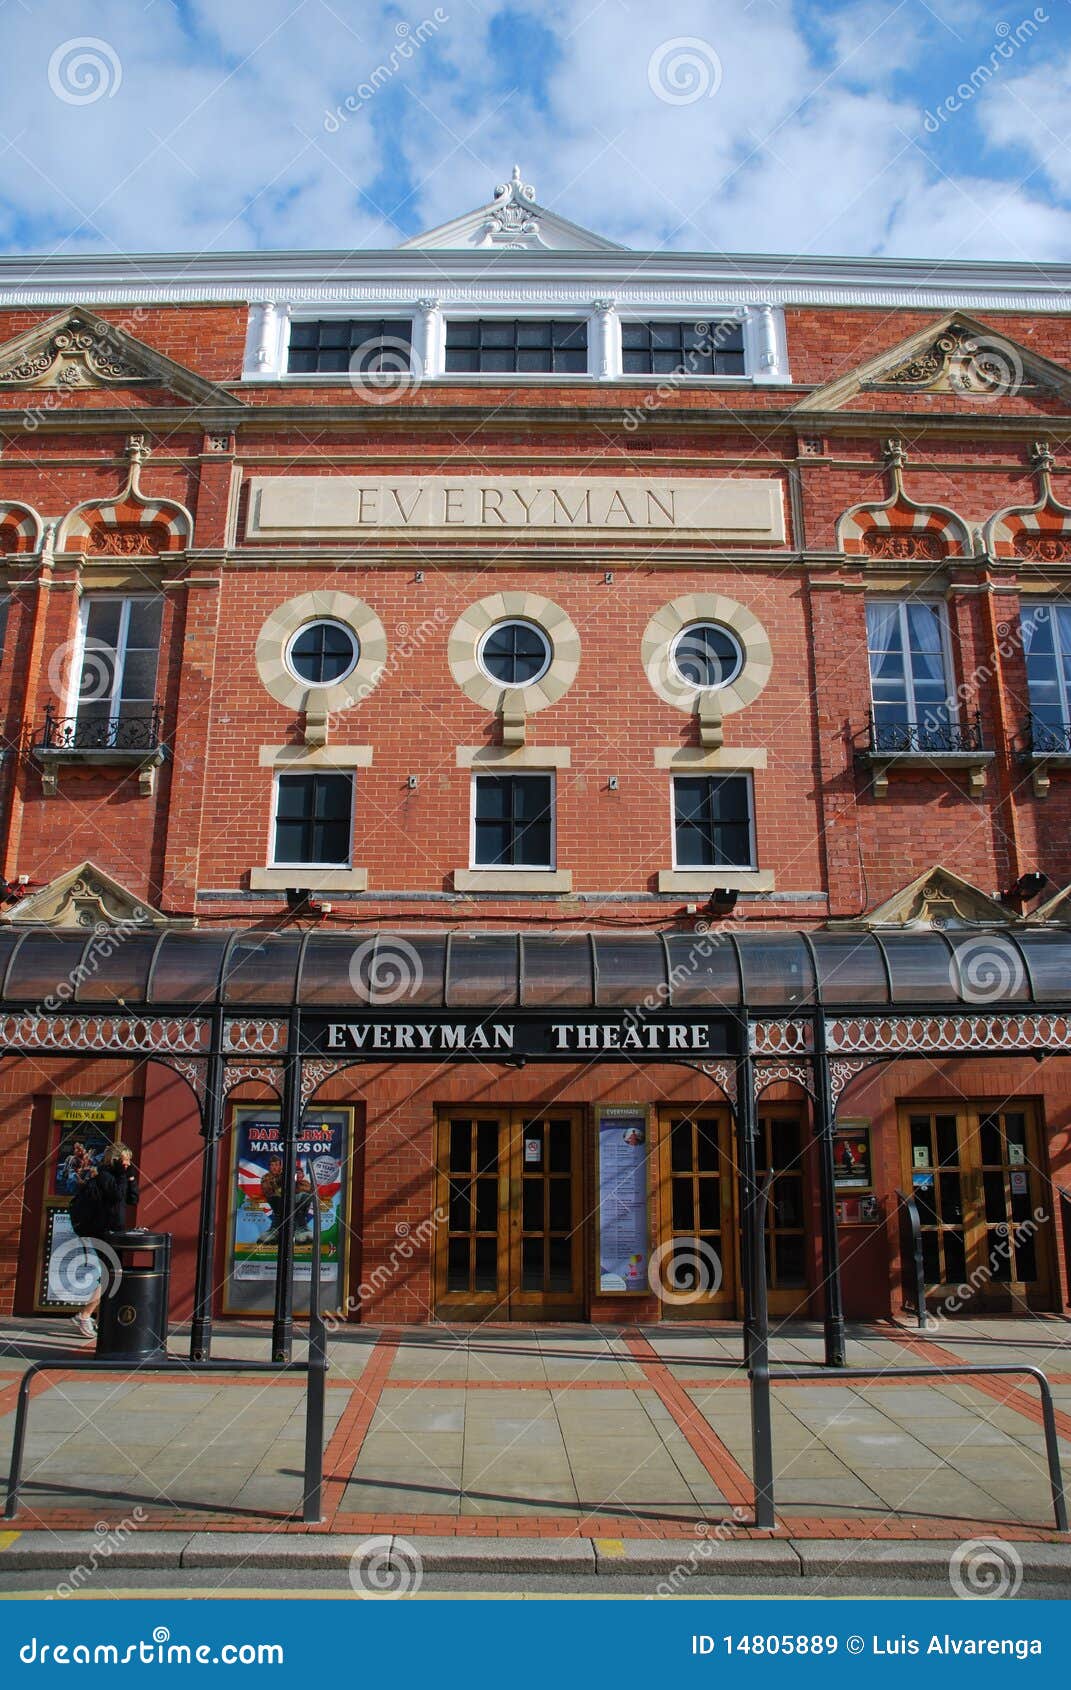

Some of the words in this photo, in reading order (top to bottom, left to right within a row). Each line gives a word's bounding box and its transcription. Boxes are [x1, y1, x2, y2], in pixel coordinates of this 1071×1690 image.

[357, 488, 676, 525] EVERYMAN
[327, 1024, 515, 1048] EVERYMAN
[551, 1024, 710, 1049] THEATRE
[251, 1142, 310, 1152] MARCES
[313, 1142, 331, 1152] ON
